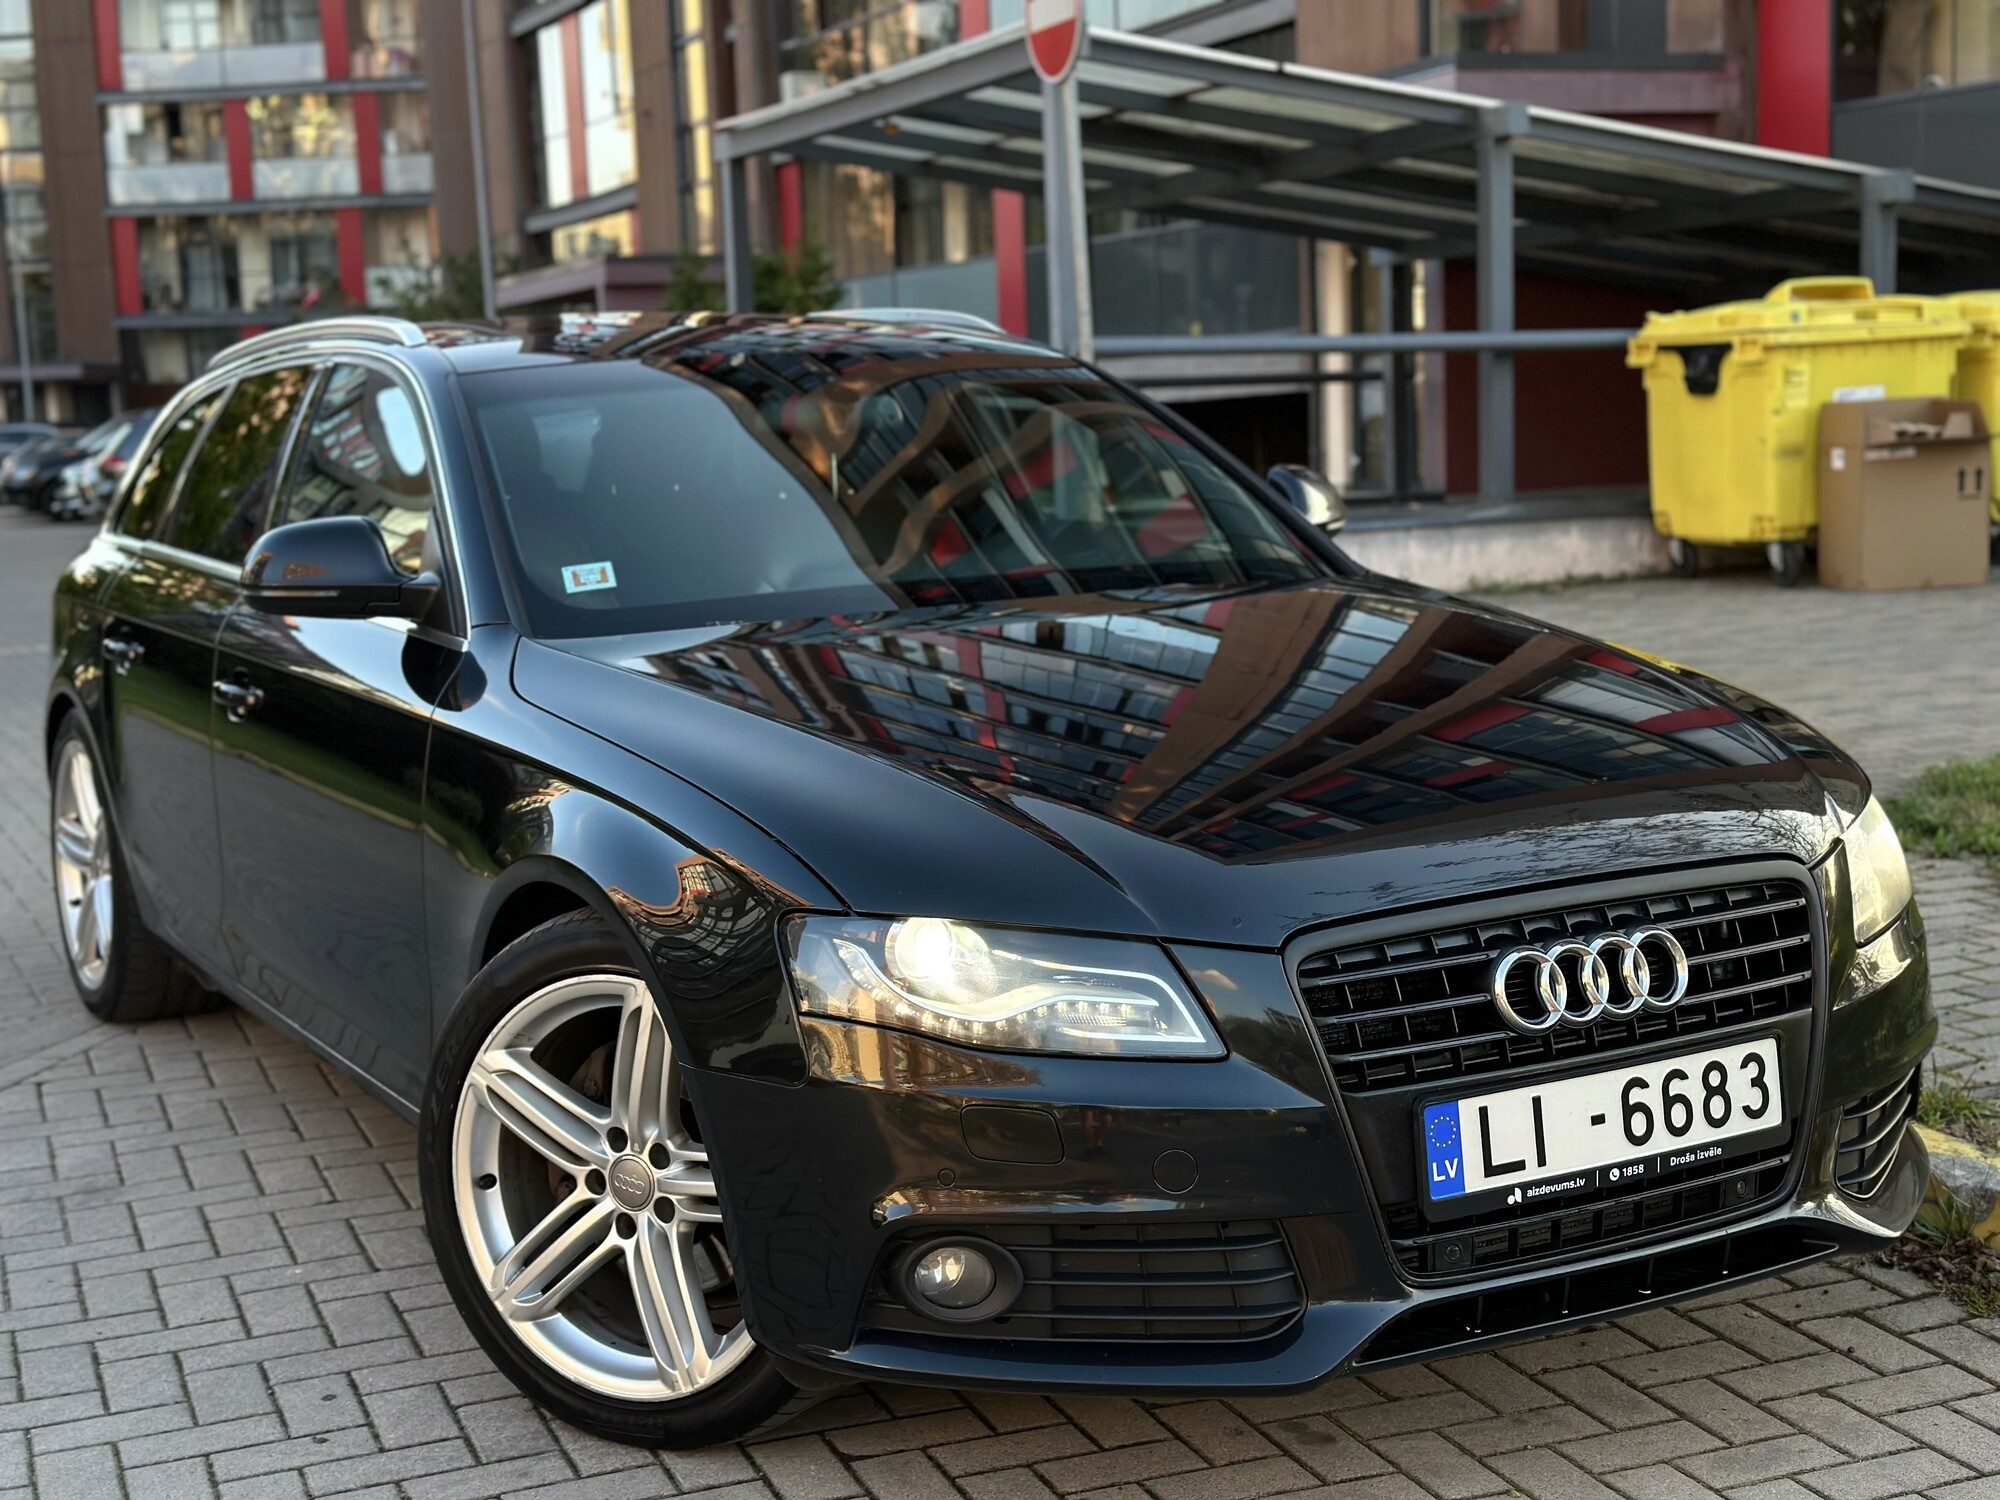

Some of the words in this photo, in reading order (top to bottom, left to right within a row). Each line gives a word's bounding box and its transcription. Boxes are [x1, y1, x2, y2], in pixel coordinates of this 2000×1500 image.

[1432, 1157, 1458, 1182] LV
[1526, 1176, 1586, 1198] aizdevums.lv
[1622, 1163, 1645, 1178] 1858
[1670, 1151, 1695, 1167] Droša
[1696, 1146, 1723, 1161] izvēle
